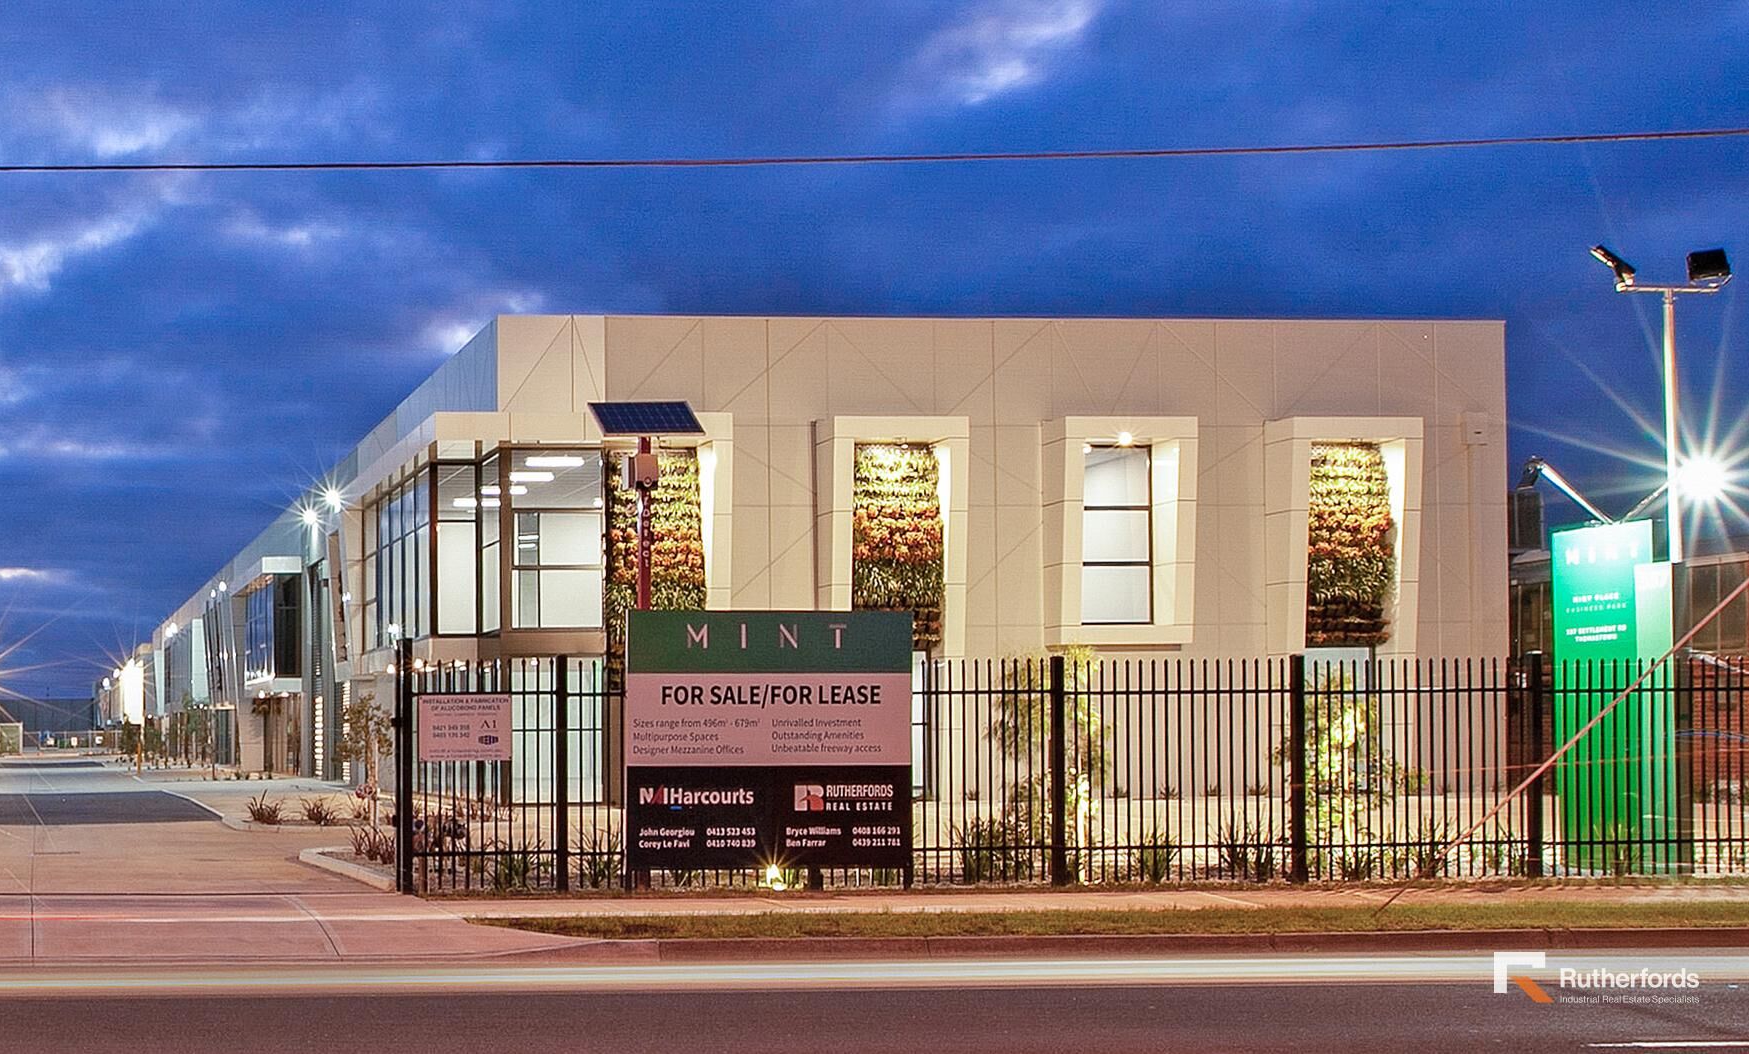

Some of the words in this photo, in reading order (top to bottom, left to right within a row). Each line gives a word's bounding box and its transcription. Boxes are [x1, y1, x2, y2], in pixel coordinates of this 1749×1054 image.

[686, 623, 847, 649] MINT
[661, 685, 704, 705] FOR
[710, 684, 813, 709] SALE/FOR
[818, 685, 882, 705] LEASE
[633, 719, 654, 728] Sizes
[655, 720, 679, 730] range
[681, 718, 701, 728] from
[771, 718, 814, 727] Unrivalled
[815, 718, 861, 728] Investment
[633, 732, 688, 743] Multipurpose
[689, 732, 719, 742] Spaces
[771, 731, 823, 741] Outstanding
[823, 730, 865, 740] Amenities
[633, 745, 669, 756] Designer
[671, 745, 714, 754] Mezzanine
[715, 744, 745, 754] Offices
[771, 743, 819, 752] Unbeatable
[820, 743, 854, 754] freeway
[854, 744, 882, 752] access
[826, 784, 894, 798] RUTHERFORDS
[826, 802, 850, 811] REAL
[856, 801, 893, 811] ESTATE
[639, 827, 659, 837] John
[786, 827, 808, 837] Bryce
[808, 826, 842, 836] Williams
[638, 839, 662, 850] Corey
[663, 839, 672, 848] Le
[786, 838, 801, 847] Ben
[802, 838, 826, 847] Farrar
